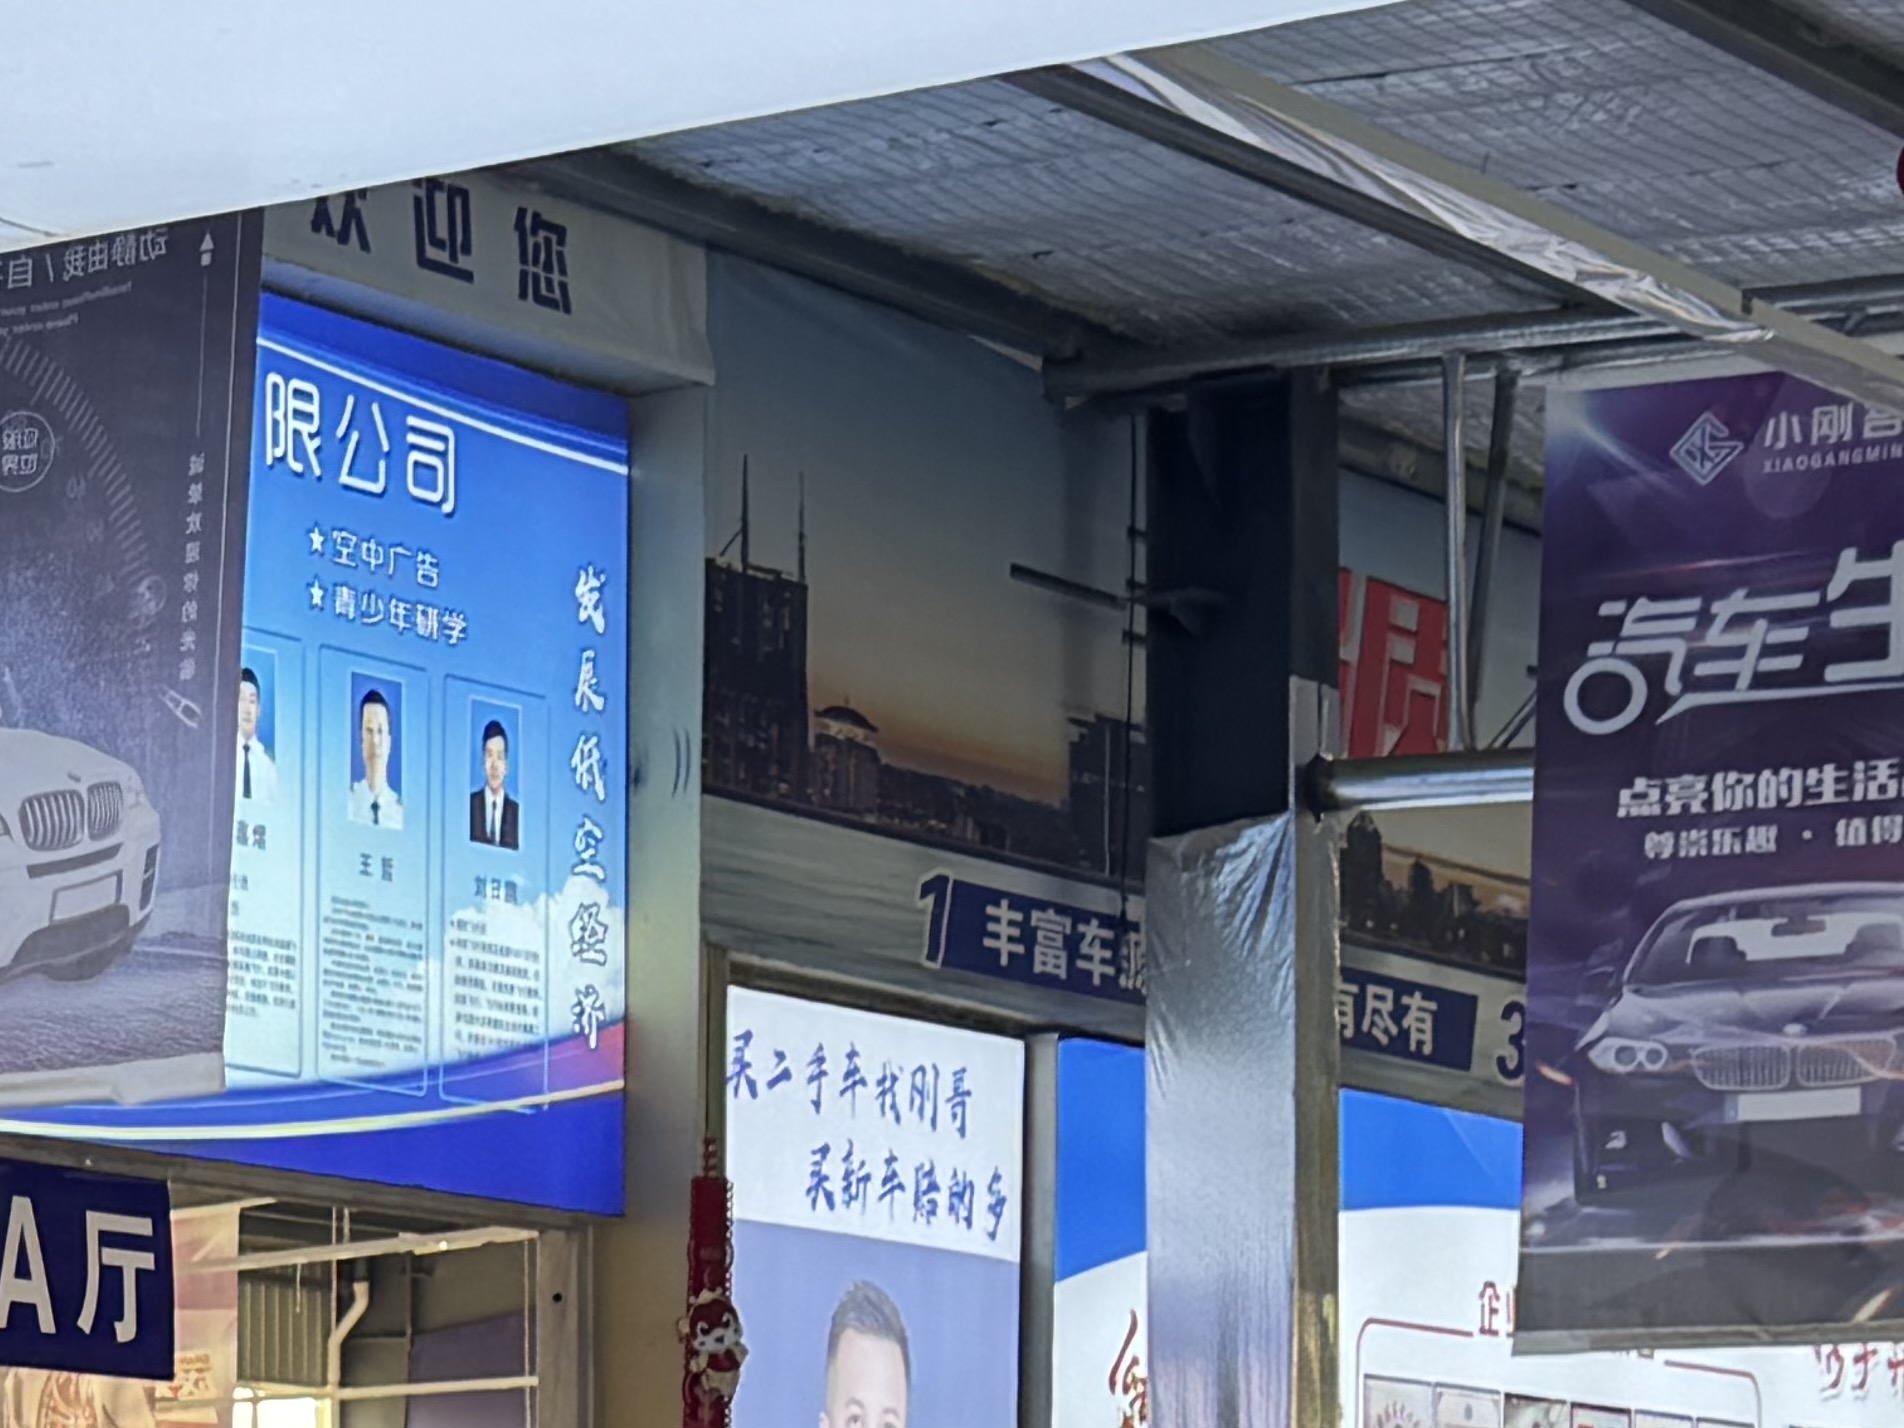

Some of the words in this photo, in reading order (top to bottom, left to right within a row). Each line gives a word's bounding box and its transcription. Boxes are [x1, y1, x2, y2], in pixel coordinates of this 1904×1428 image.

[264, 370, 456, 516] 限公司
[330, 529, 441, 590] 空中广告
[332, 580, 469, 648] 青少年研学
[568, 563, 608, 1050] 发展低空经济
[726, 1028, 973, 1140] 买二手车找刚哥
